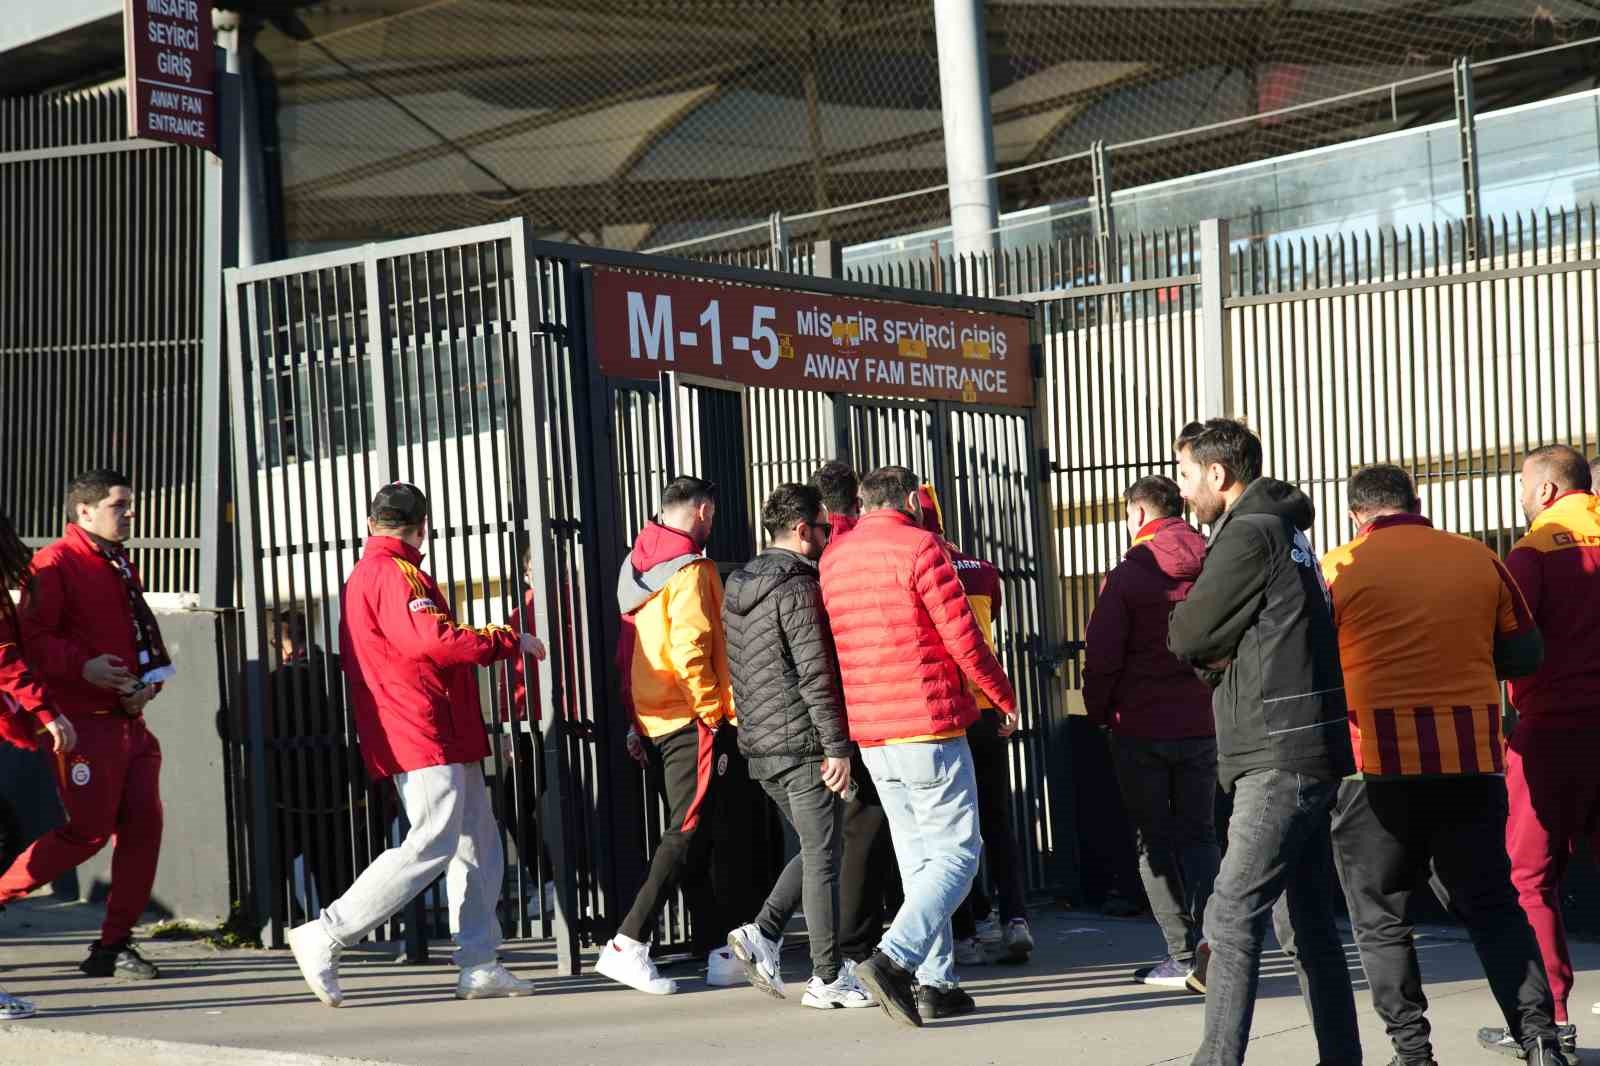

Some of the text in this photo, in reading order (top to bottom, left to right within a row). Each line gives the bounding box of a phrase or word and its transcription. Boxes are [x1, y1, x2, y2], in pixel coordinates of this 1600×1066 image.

[148, 22, 199, 50] SEYİRCİ
[157, 50, 192, 82] GİRİŞ
[150, 90, 202, 114] AWAY FAN
[148, 113, 205, 138] ENTRANCE
[627, 291, 779, 370] M-1-5
[804, 353, 859, 381] AWAY
[865, 359, 904, 385] FAM
[911, 363, 1008, 393] ENTRANCE
